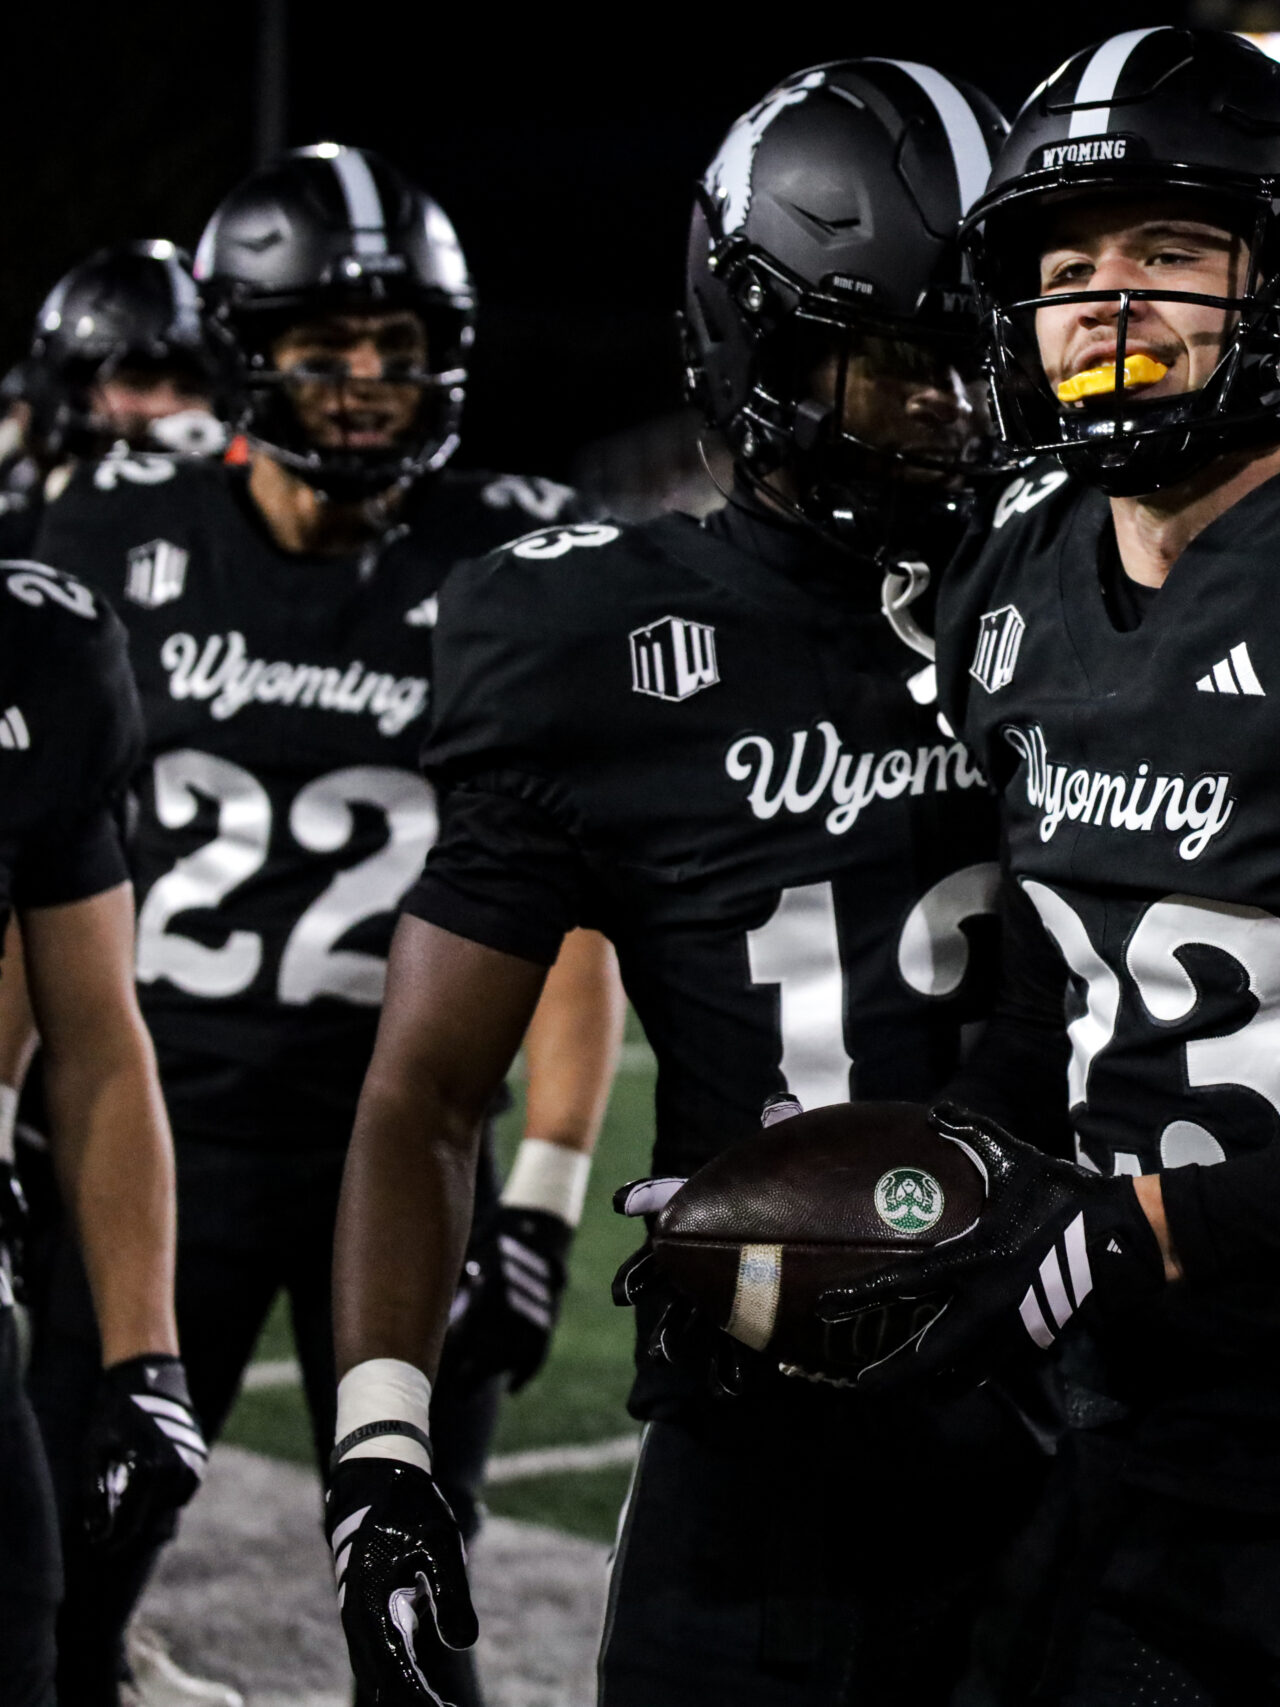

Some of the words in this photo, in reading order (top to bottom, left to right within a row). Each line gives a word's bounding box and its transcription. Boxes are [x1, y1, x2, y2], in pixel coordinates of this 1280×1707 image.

[1043, 140, 1127, 169] WYOMING
[161, 631, 428, 737] Wyoming
[725, 721, 988, 835] Wyom
[1004, 726, 1233, 860] Wyoming
[136, 748, 438, 1005] 22
